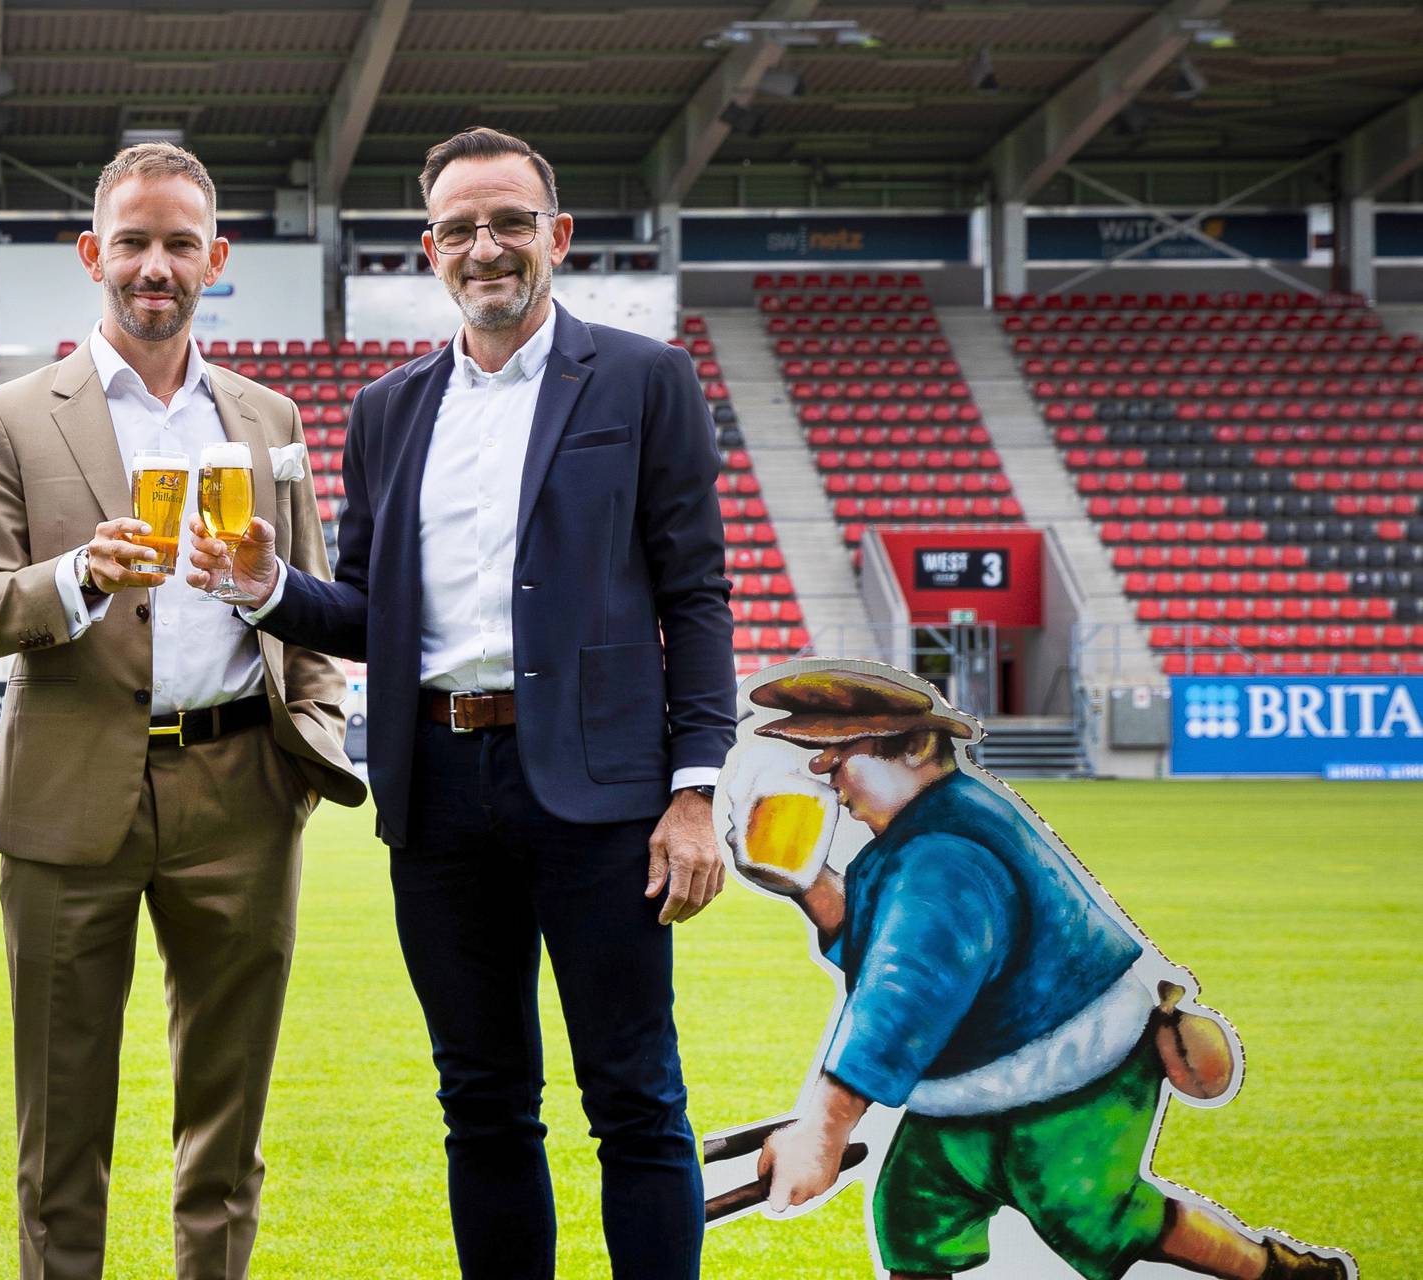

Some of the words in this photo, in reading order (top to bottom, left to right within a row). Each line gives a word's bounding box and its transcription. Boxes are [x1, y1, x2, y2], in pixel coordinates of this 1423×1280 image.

[922, 552, 970, 573] WEST
[982, 552, 1002, 588] 3
[1244, 684, 1423, 738] BRITA
